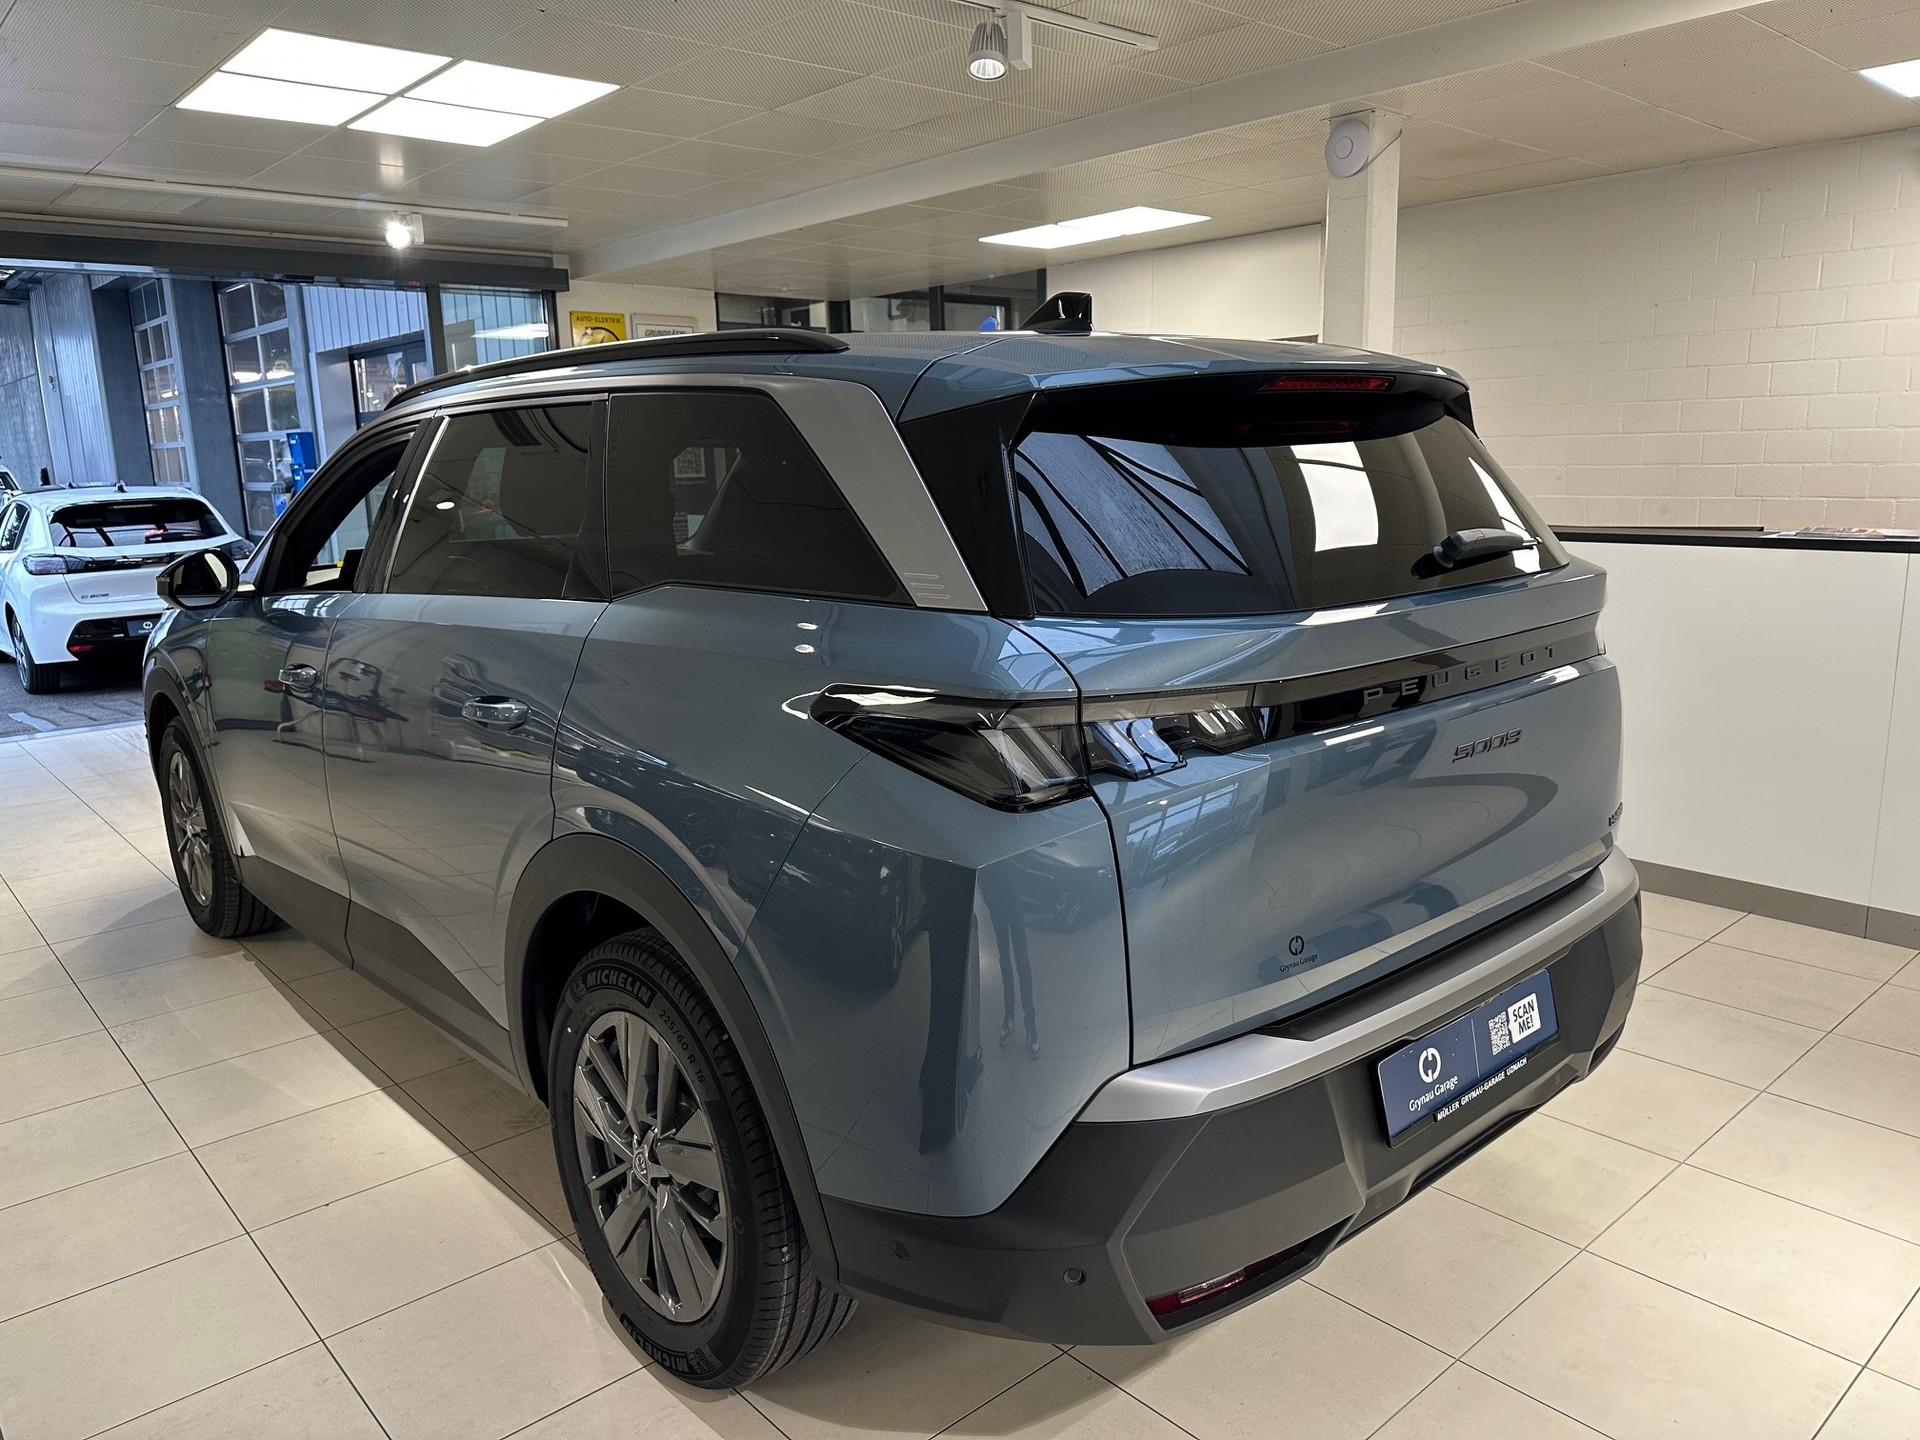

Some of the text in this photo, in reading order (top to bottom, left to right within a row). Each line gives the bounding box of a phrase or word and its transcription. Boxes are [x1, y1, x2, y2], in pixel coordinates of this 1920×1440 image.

[576, 315, 621, 324] AUTO-ELEKTRIK
[1363, 643, 1559, 705] PEUGEOT
[1452, 727, 1523, 763] 5008
[586, 969, 651, 1003] MICHELIN
[1512, 998, 1535, 1023] SCAN
[1518, 1015, 1534, 1035] ME!
[659, 1009, 706, 1084] 225/60 R 18
[1409, 1076, 1458, 1111] Grynau Garage
[1437, 1101, 1460, 1121] MÜLLER
[1460, 1071, 1505, 1106] GRYNAU-GARAGE
[622, 1318, 690, 1373] MICHELIN
